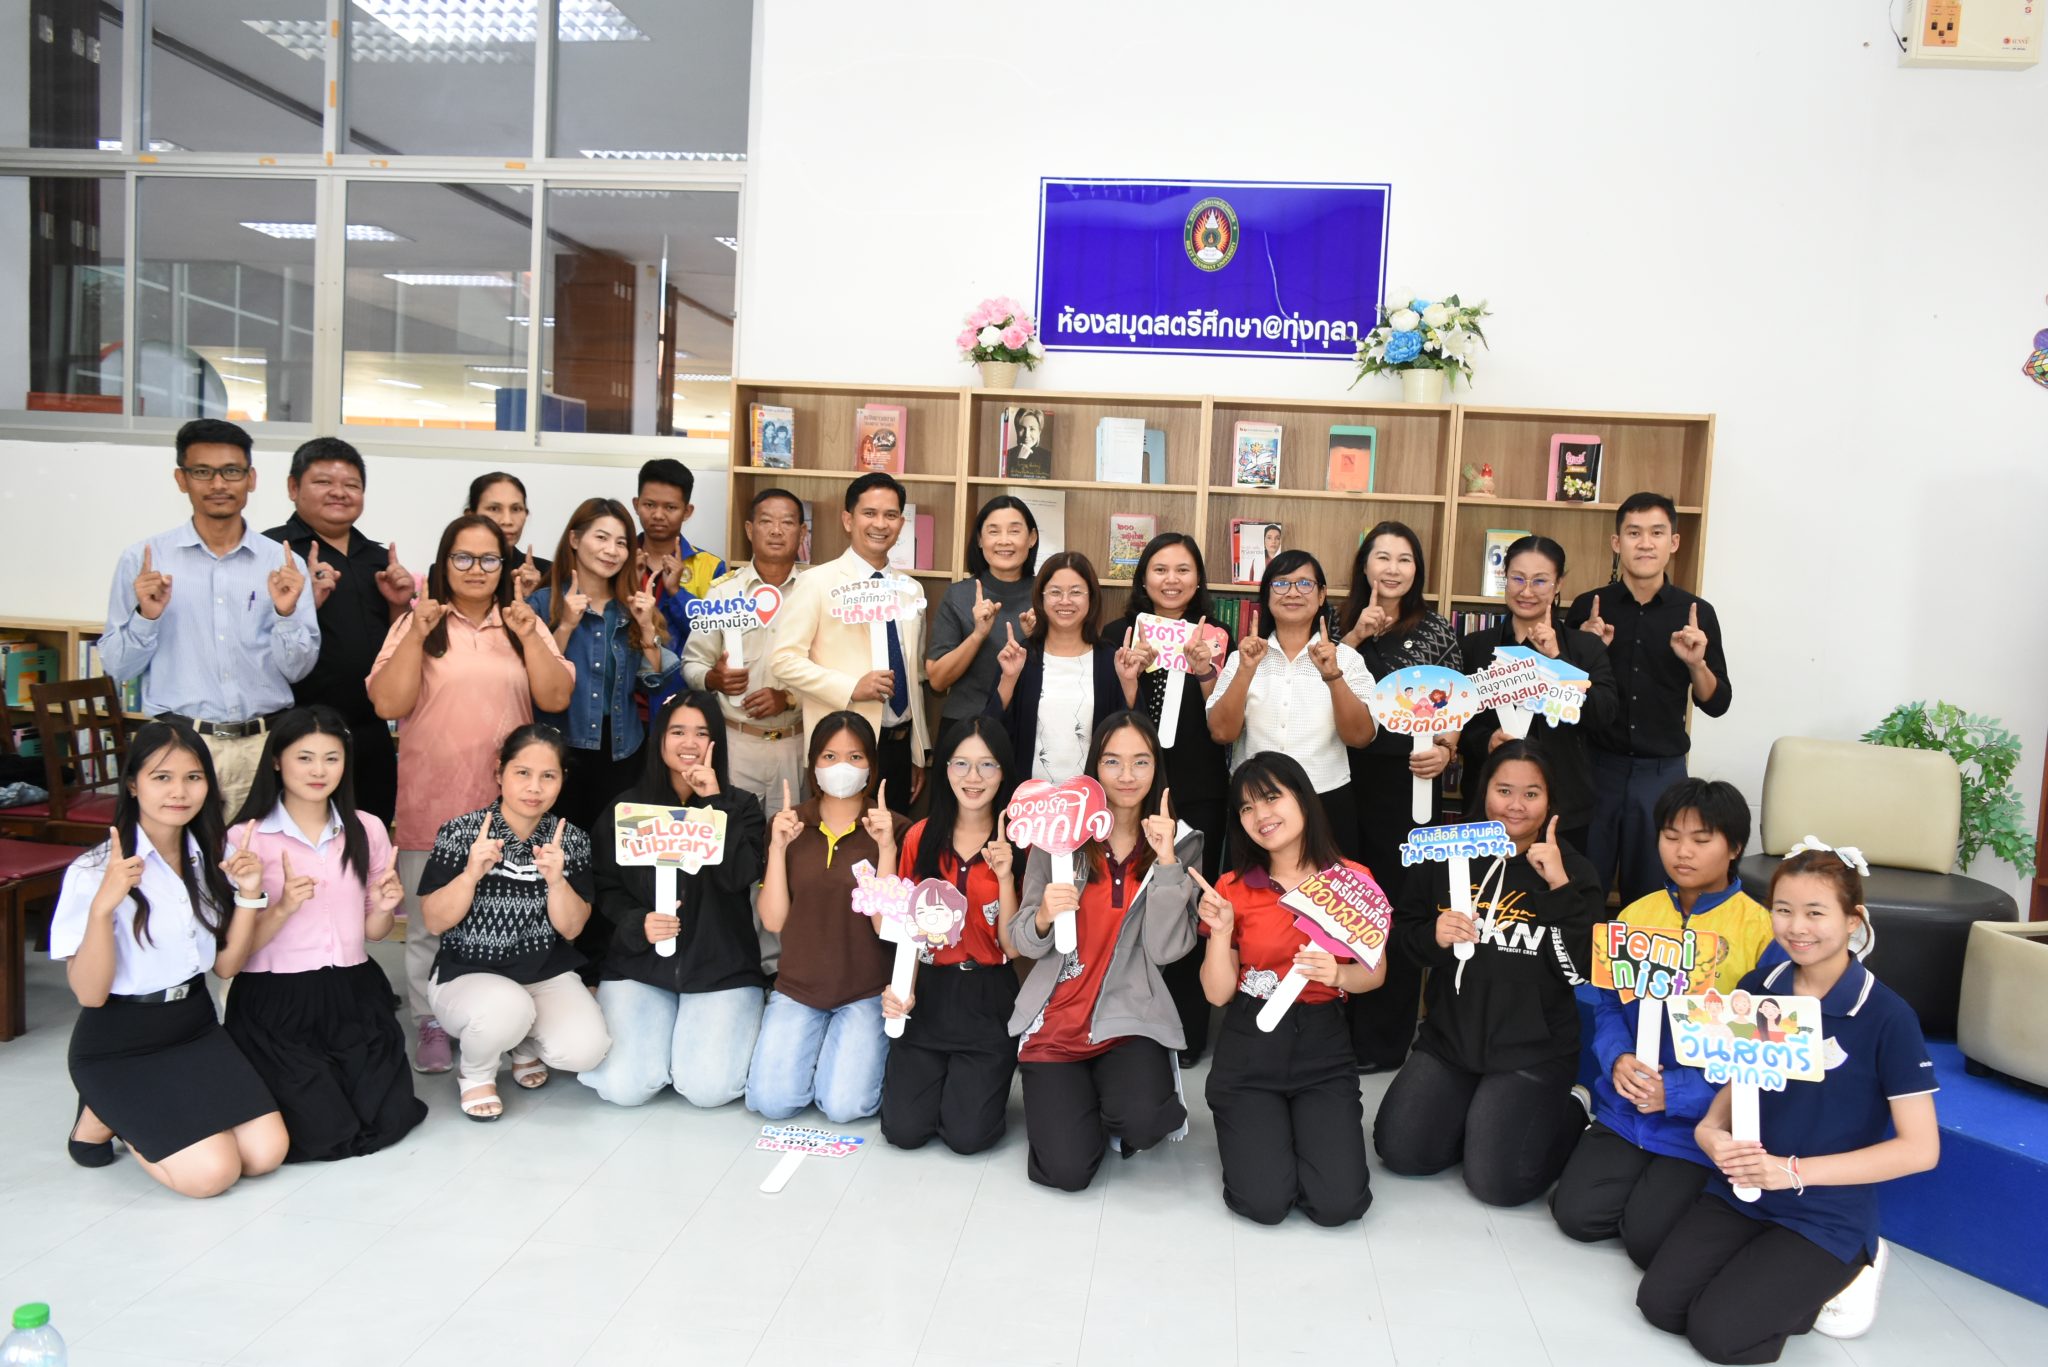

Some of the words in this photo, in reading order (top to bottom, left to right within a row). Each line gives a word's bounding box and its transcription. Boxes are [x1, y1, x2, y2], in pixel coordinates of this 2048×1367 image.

[1057, 305, 1359, 347] ห้องสมุดสตรีศึกษา@ทุ่งกุลา
[687, 591, 757, 616] คนเก่ง
[691, 611, 757, 634] อยู่ทางนี้จ้า
[1387, 710, 1462, 733] ชีวิตดีๆ
[655, 819, 713, 839] Love
[1411, 827, 1459, 844] หนังสือดี
[1461, 823, 1503, 838] อ่านต่อ
[630, 837, 719, 860] Library
[1298, 874, 1385, 950] ห้องสมุด
[1498, 946, 1522, 954] UPPERCUT
[1609, 922, 1696, 970] Femi
[1613, 960, 1689, 998] nist
[1680, 1024, 1811, 1072] วันสตรี
[1708, 1063, 1783, 1089] สากล
